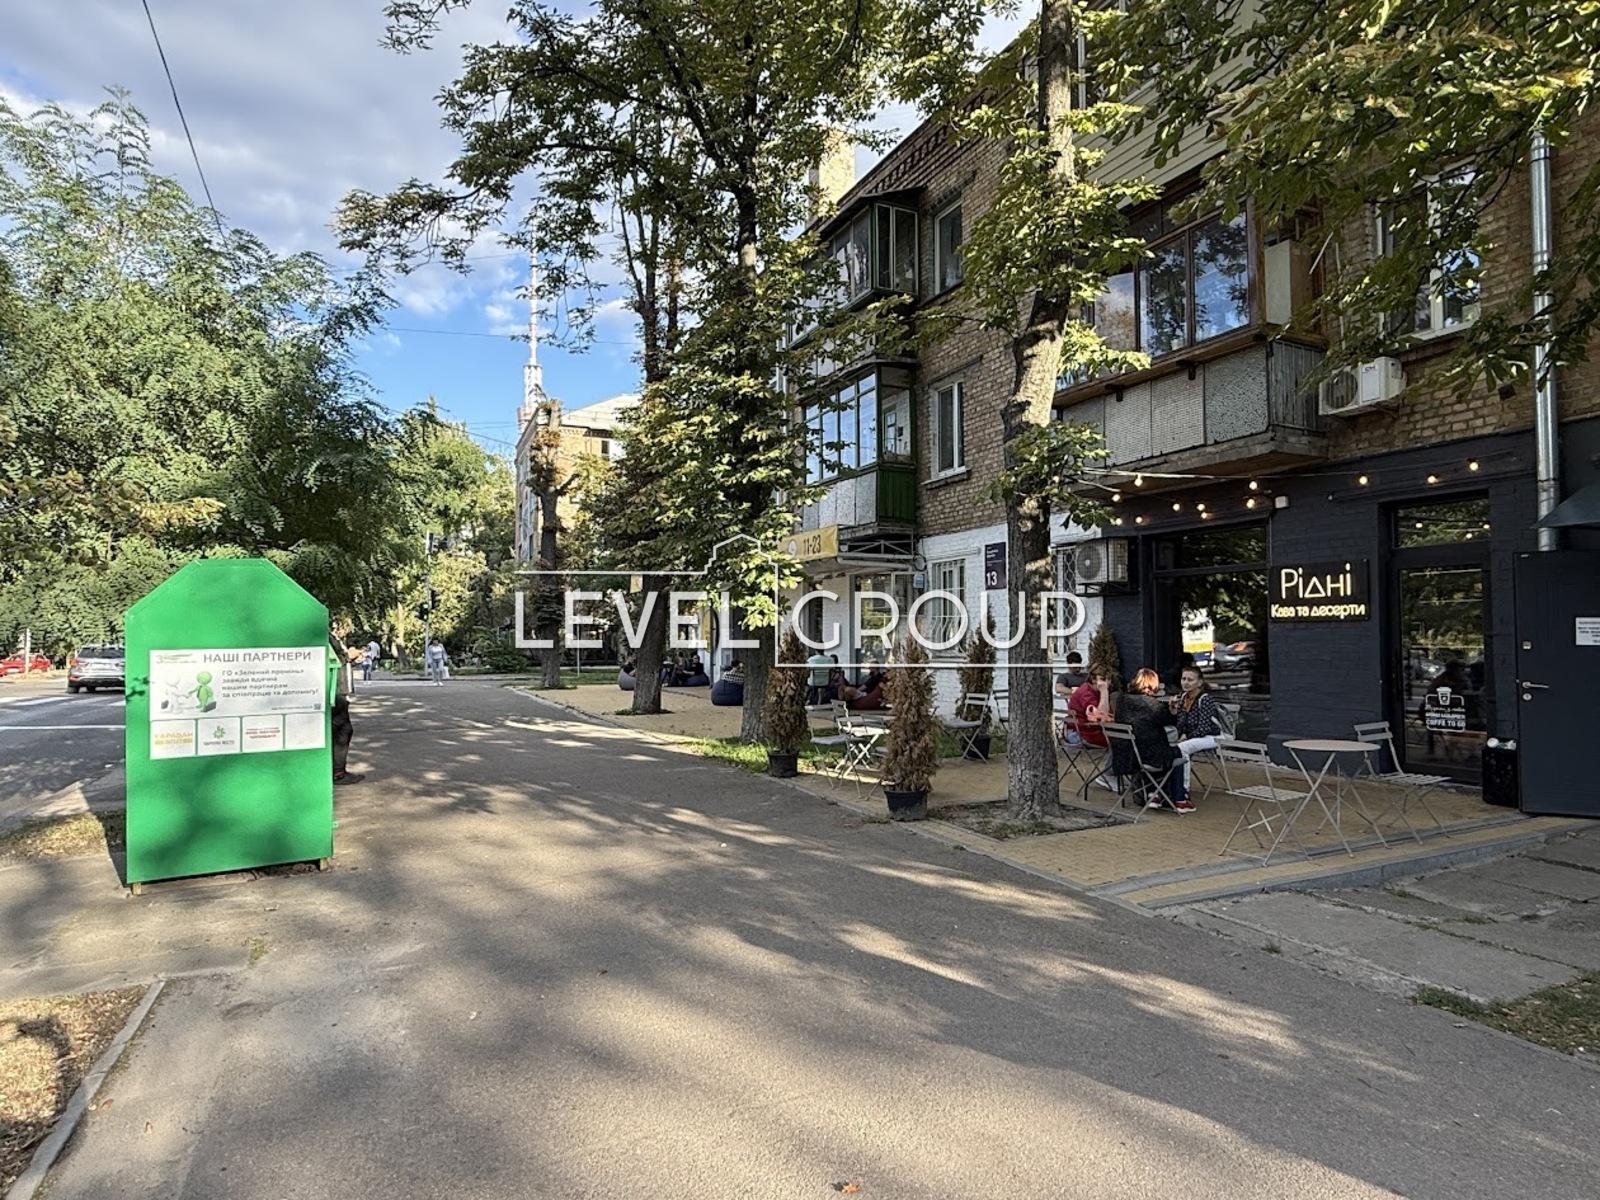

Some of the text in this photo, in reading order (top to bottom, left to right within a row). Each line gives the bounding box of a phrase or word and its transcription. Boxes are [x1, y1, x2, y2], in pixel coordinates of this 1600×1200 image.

[803, 534, 821, 556] 11-23
[986, 571, 998, 586] 13
[1270, 604, 1366, 620] Кава та десерти
[203, 651, 312, 664] НАШІ ПАРТНЕРИ
